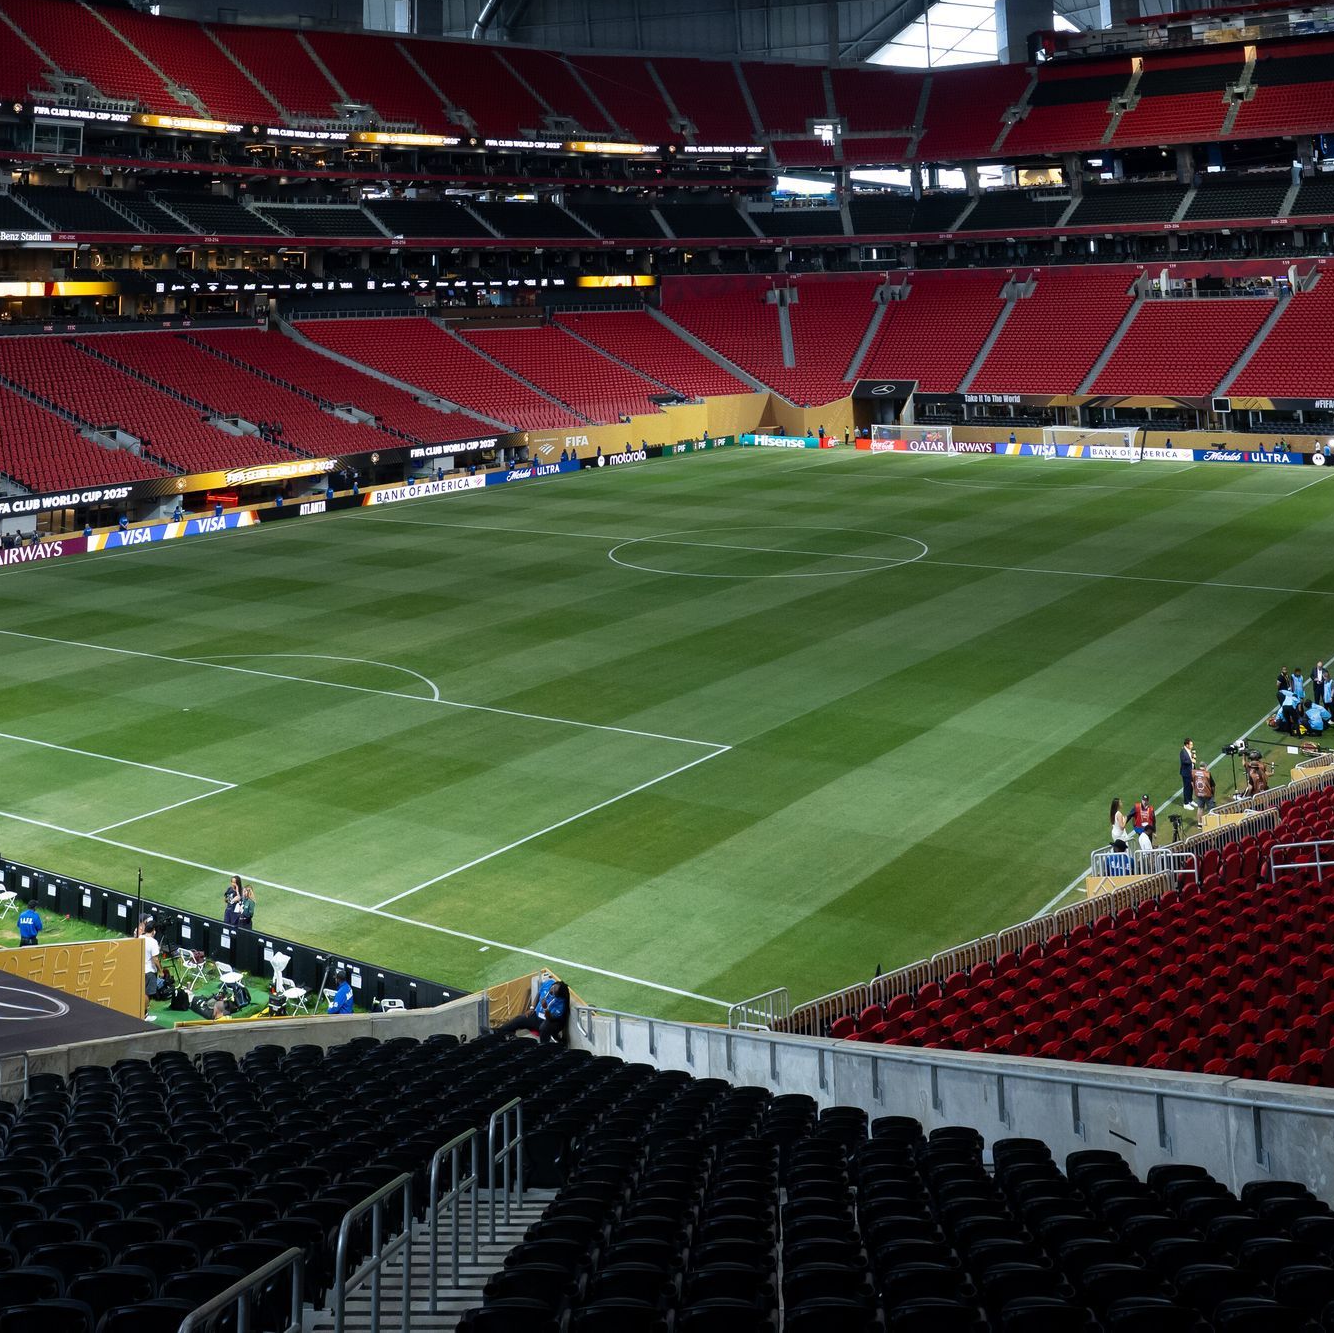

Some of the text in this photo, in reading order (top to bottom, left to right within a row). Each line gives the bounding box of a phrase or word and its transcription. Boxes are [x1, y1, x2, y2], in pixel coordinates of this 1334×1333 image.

[20, 233, 51, 241] Stadium
[1003, 395, 1020, 403] World
[566, 436, 589, 446] FIFA
[717, 438, 726, 446] PIF
[754, 435, 805, 448] Hisense
[910, 441, 992, 453] QATAR AIRWAYS
[411, 448, 425, 458] FIFA
[426, 446, 442, 455] CLUB
[443, 443, 465, 453] WORLD
[466, 441, 479, 450] CUP
[677, 444, 686, 452] PIF
[1030, 445, 1056, 455] VISA
[1092, 449, 1117, 457] BANK
[1134, 450, 1178, 458] AMERICA
[610, 449, 646, 465] motorola
[1204, 451, 1290, 462] Michelob ULTRA
[507, 464, 559, 481] Michelob ULTRA
[377, 479, 469, 502] BANK OF AMERICA
[13, 500, 40, 512] CLUB
[42, 494, 80, 508] WORLD
[81, 490, 102, 503] CUP
[300, 501, 326, 515] ATLANTA
[197, 517, 226, 533] VISA
[119, 528, 151, 546] VISA
